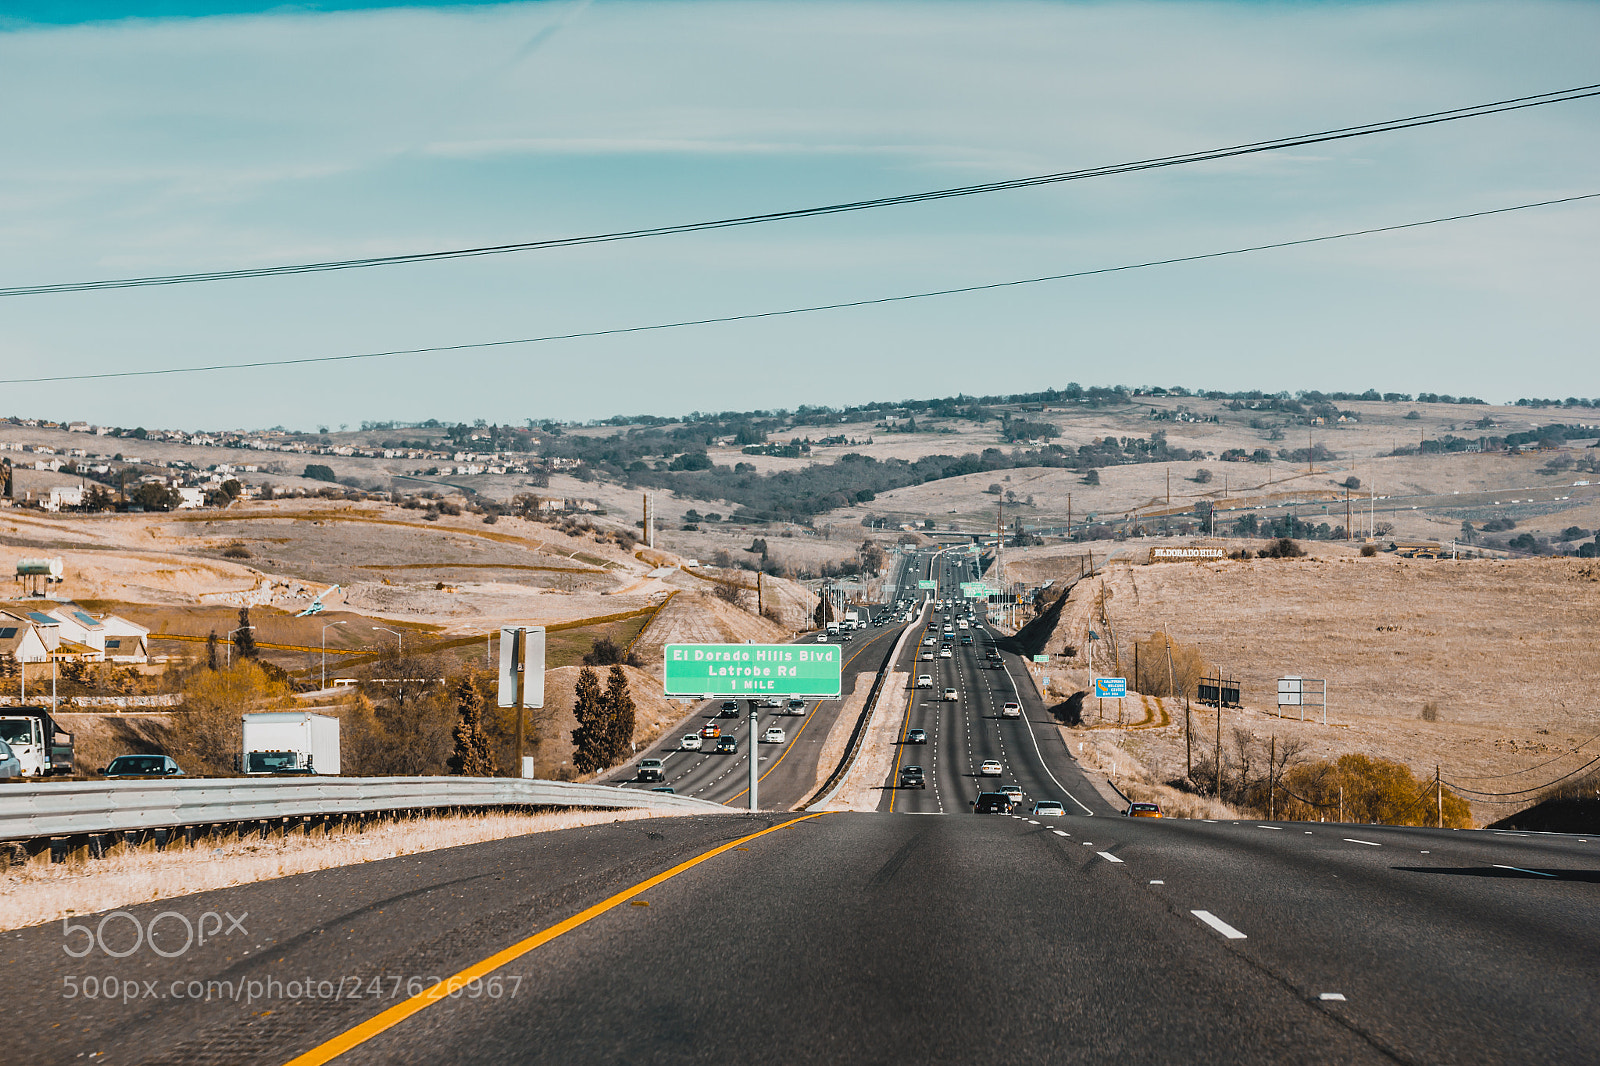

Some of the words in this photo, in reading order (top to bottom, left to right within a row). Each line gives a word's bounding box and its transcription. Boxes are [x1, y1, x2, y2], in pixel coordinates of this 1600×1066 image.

[673, 650, 688, 661] El
[695, 650, 749, 661] Dorado
[757, 651, 792, 661] Hills
[800, 651, 833, 662] Blvd
[708, 665, 771, 676] Latrobe
[778, 666, 797, 676] Rd
[731, 680, 736, 690] 1
[744, 681, 775, 689] MILE
